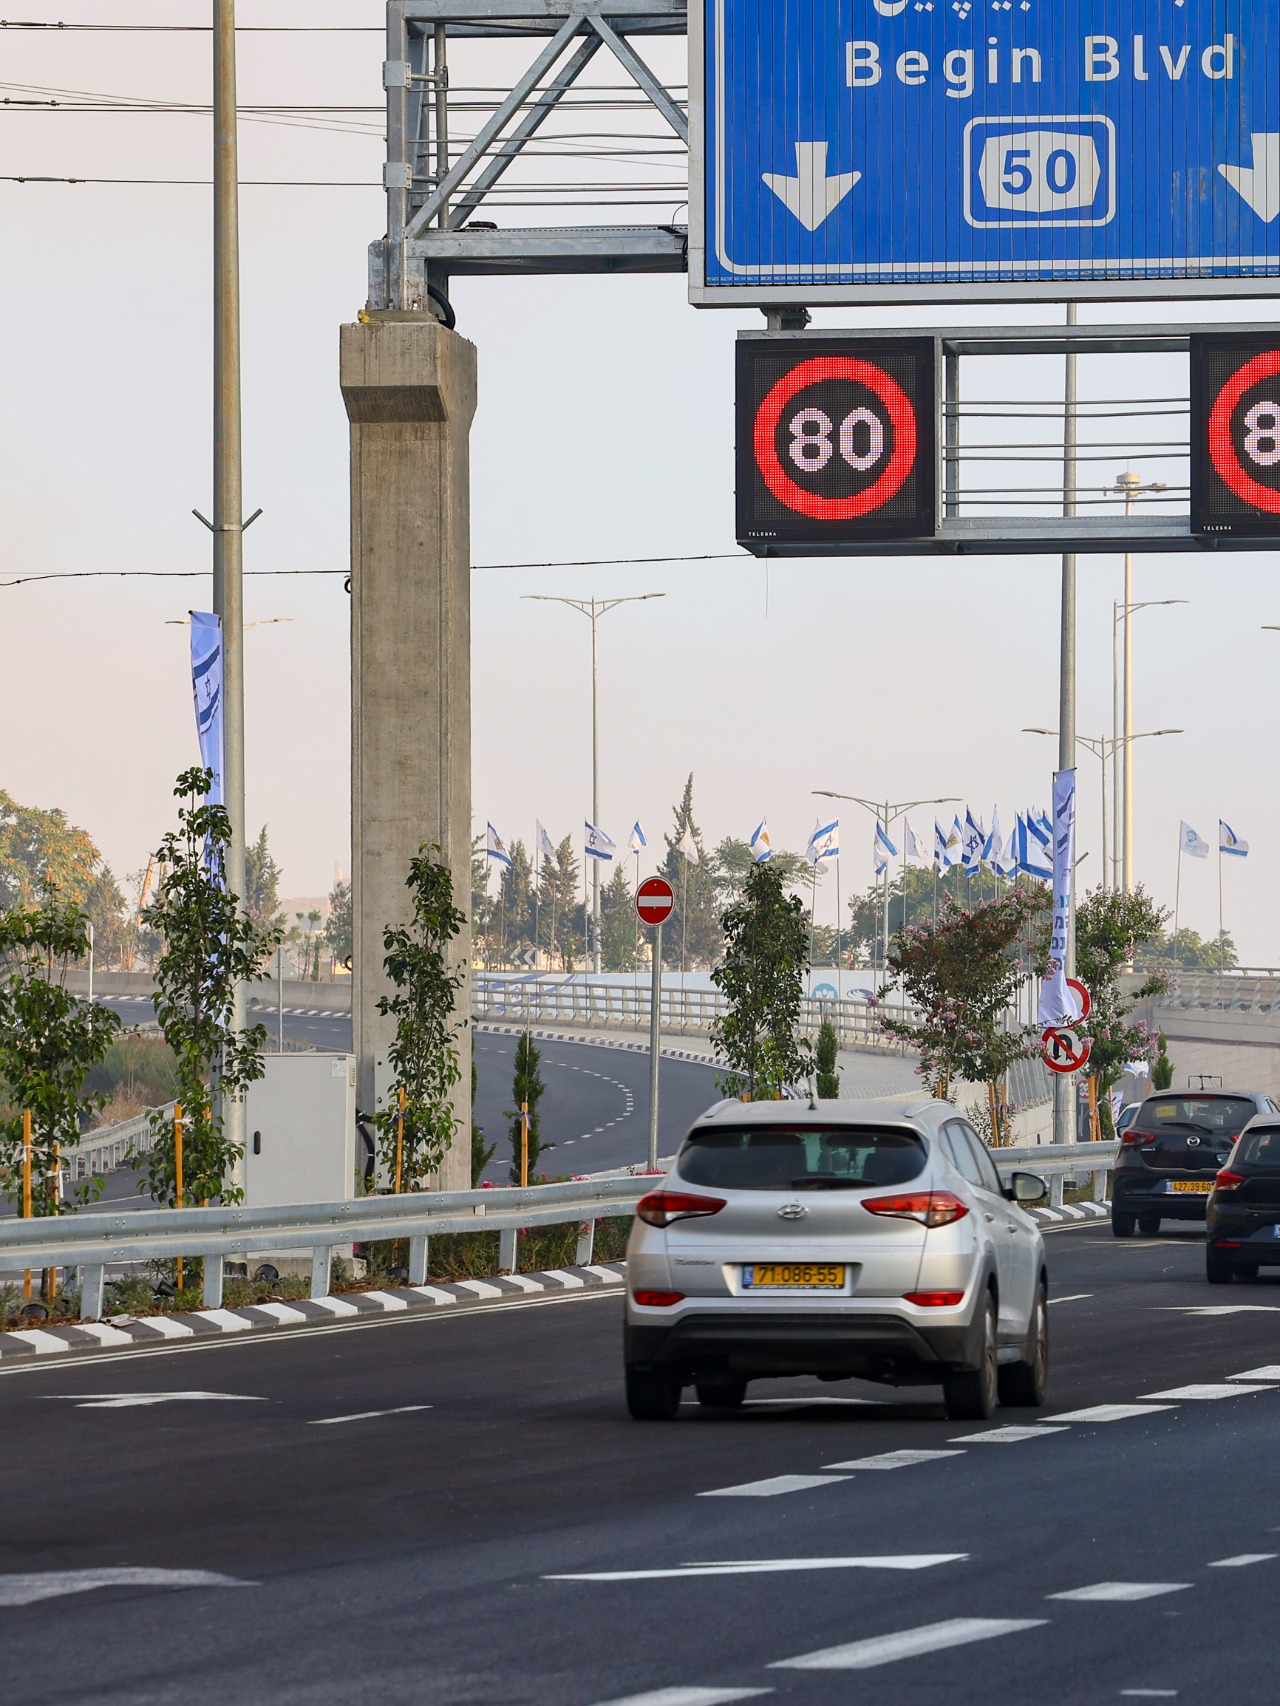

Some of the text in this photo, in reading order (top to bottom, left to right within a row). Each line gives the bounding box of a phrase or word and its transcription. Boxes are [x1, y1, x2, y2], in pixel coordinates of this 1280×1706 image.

[845, 34, 1236, 98] Begin Blvd
[1001, 149, 1077, 196] 50
[788, 407, 884, 472] 80
